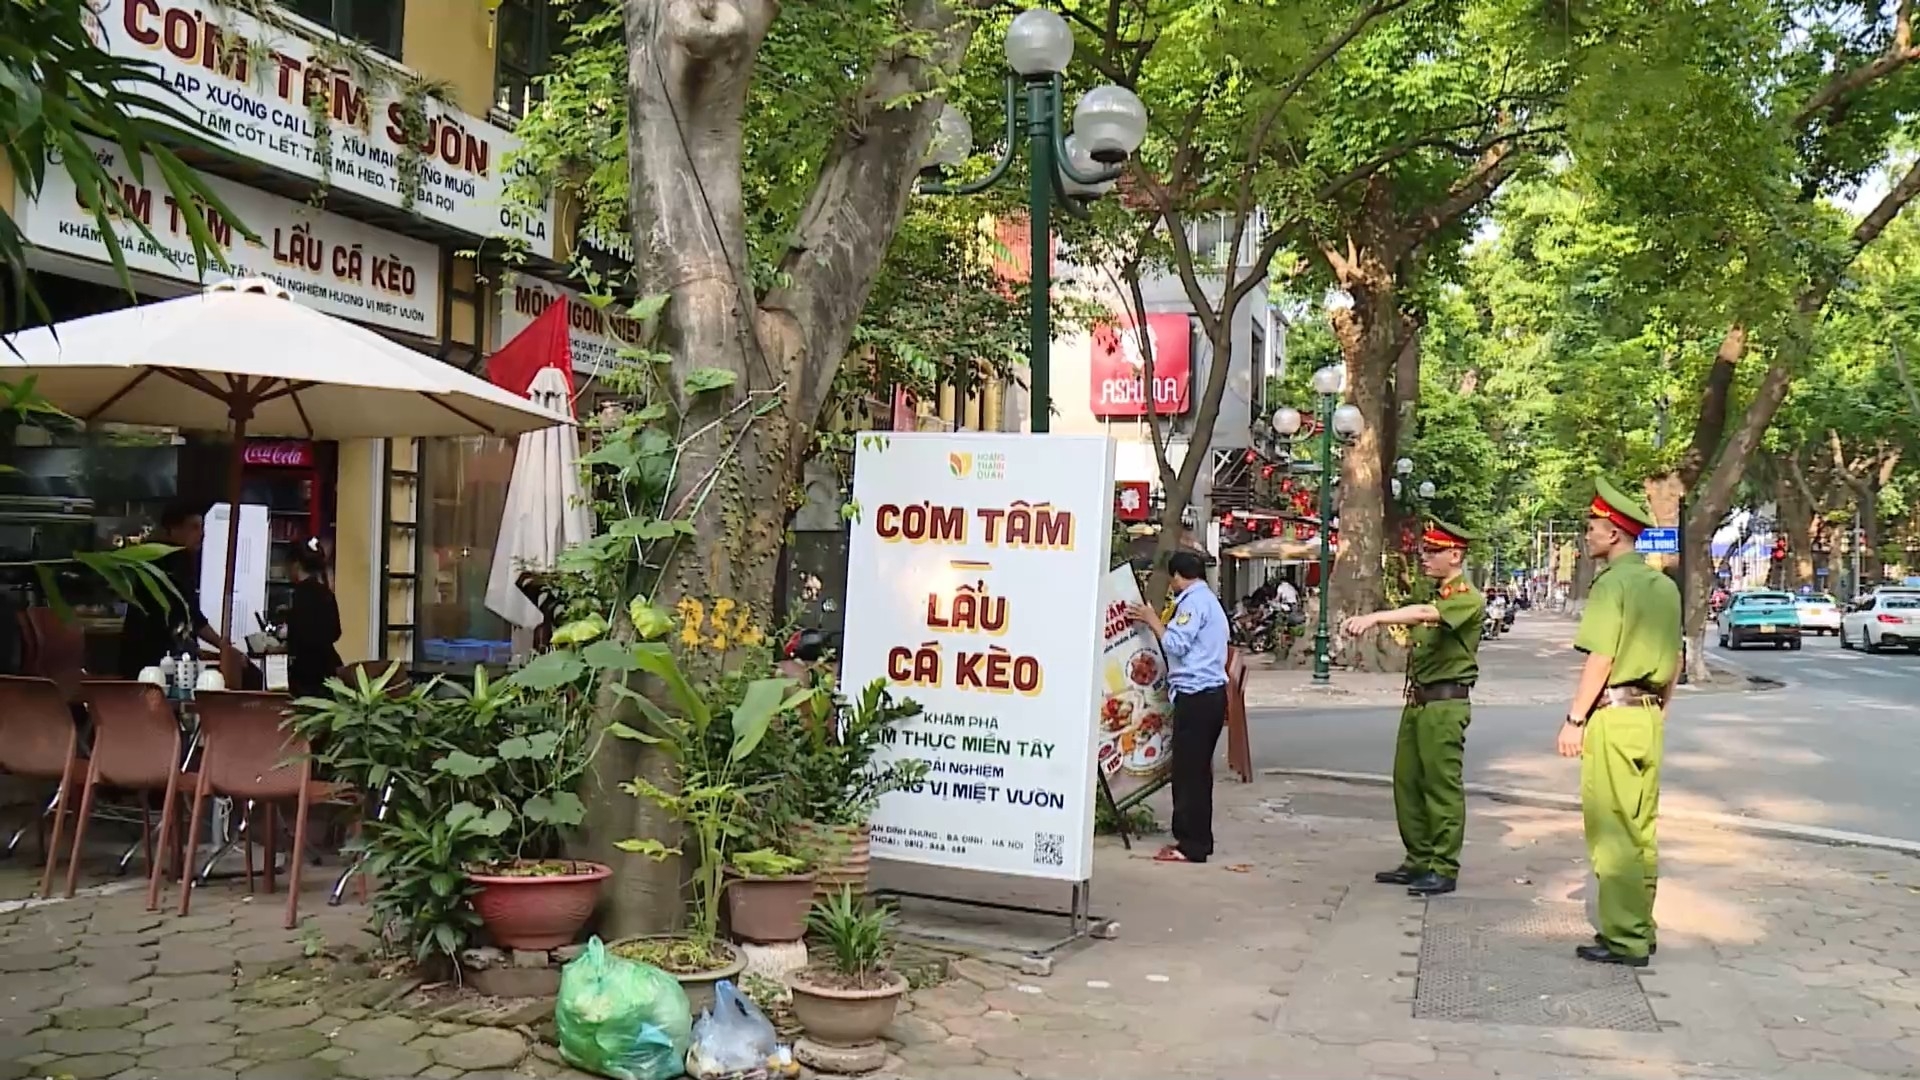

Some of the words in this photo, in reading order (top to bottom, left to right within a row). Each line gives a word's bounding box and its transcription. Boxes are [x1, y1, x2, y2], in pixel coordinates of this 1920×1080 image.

[272, 109, 298, 133] CAI
[417, 187, 432, 205] BA
[332, 243, 363, 283] CÁ
[372, 253, 416, 298] KÈO
[876, 500, 967, 544] CƠM
[977, 500, 1075, 550] TẤM
[927, 579, 1009, 636] LẨU
[888, 641, 942, 688] CÁ
[956, 645, 1043, 697] KÈO
[876, 728, 897, 745] M
[902, 730, 956, 751] THỰC
[962, 731, 1011, 756] MIỀN
[1017, 738, 1055, 760] TÂY
[930, 780, 948, 801] VỊ
[952, 782, 1000, 804] MIỆT
